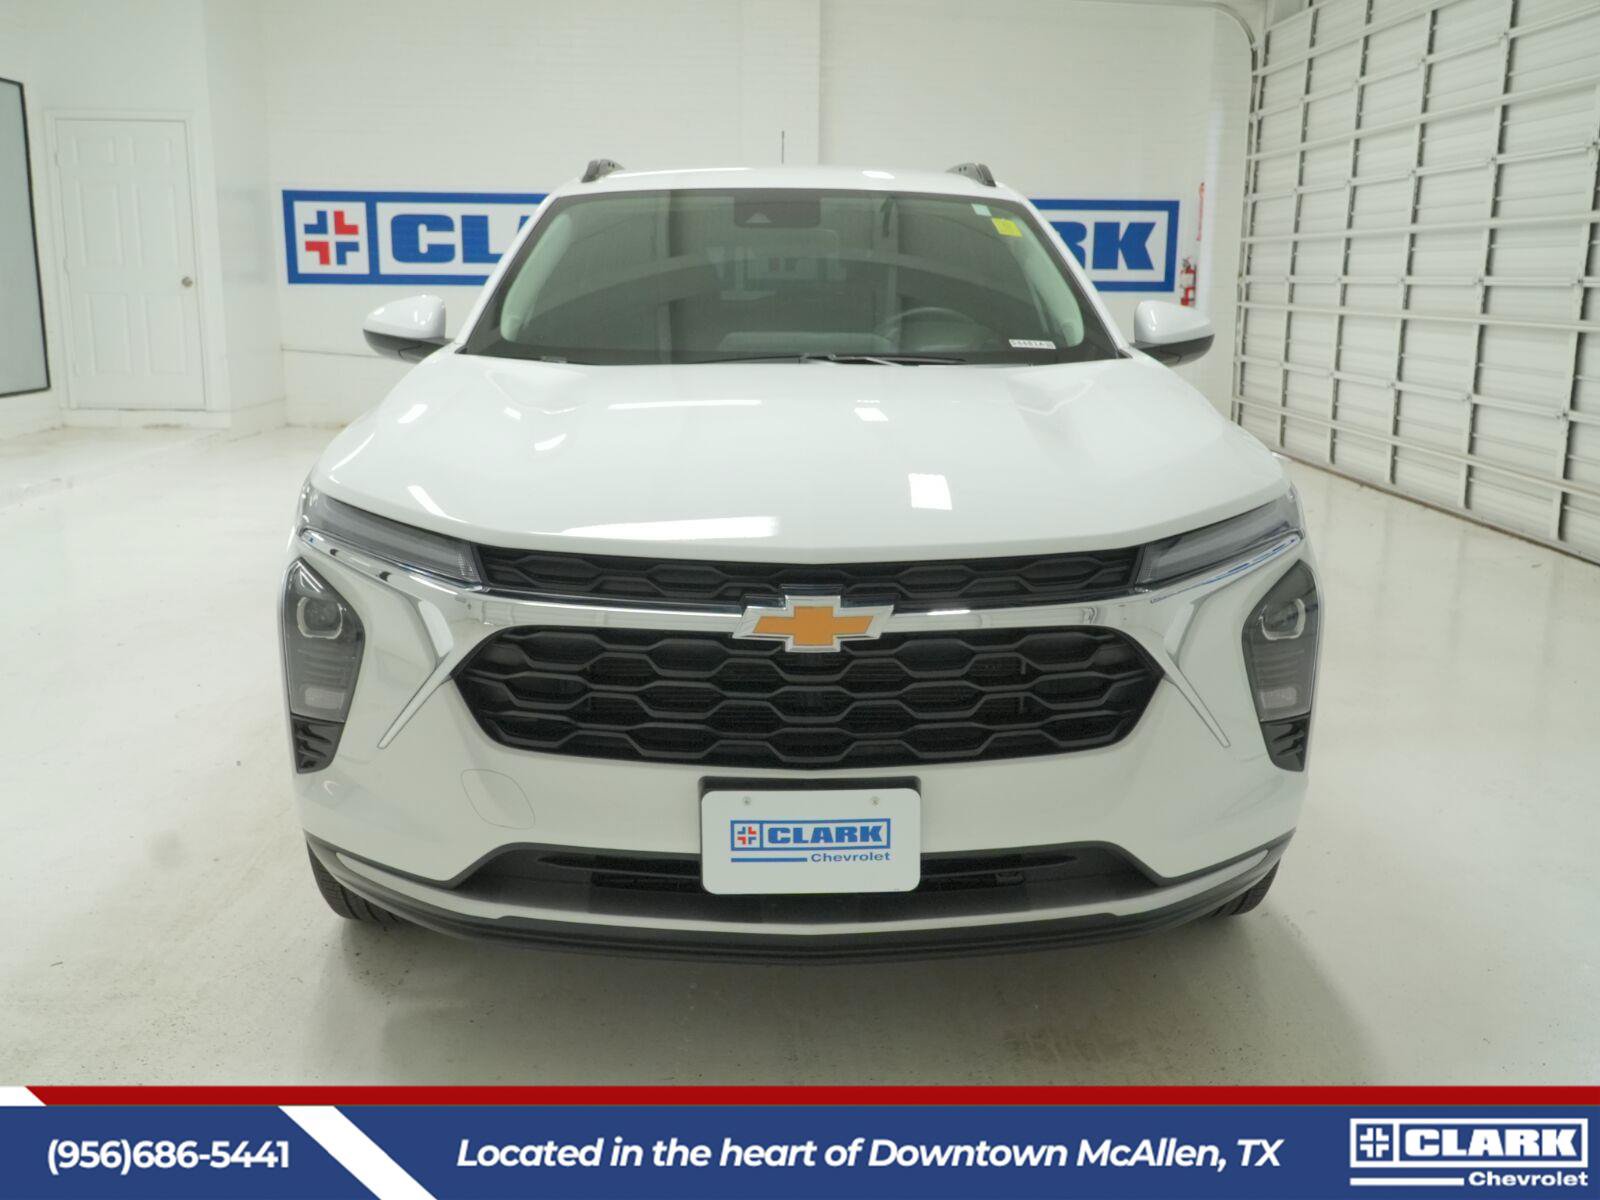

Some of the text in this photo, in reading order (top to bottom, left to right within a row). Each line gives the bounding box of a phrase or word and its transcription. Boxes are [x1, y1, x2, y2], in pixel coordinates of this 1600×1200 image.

[391, 214, 530, 264] CL
[768, 826, 883, 844] CLARK
[811, 852, 891, 863] Chevrolet
